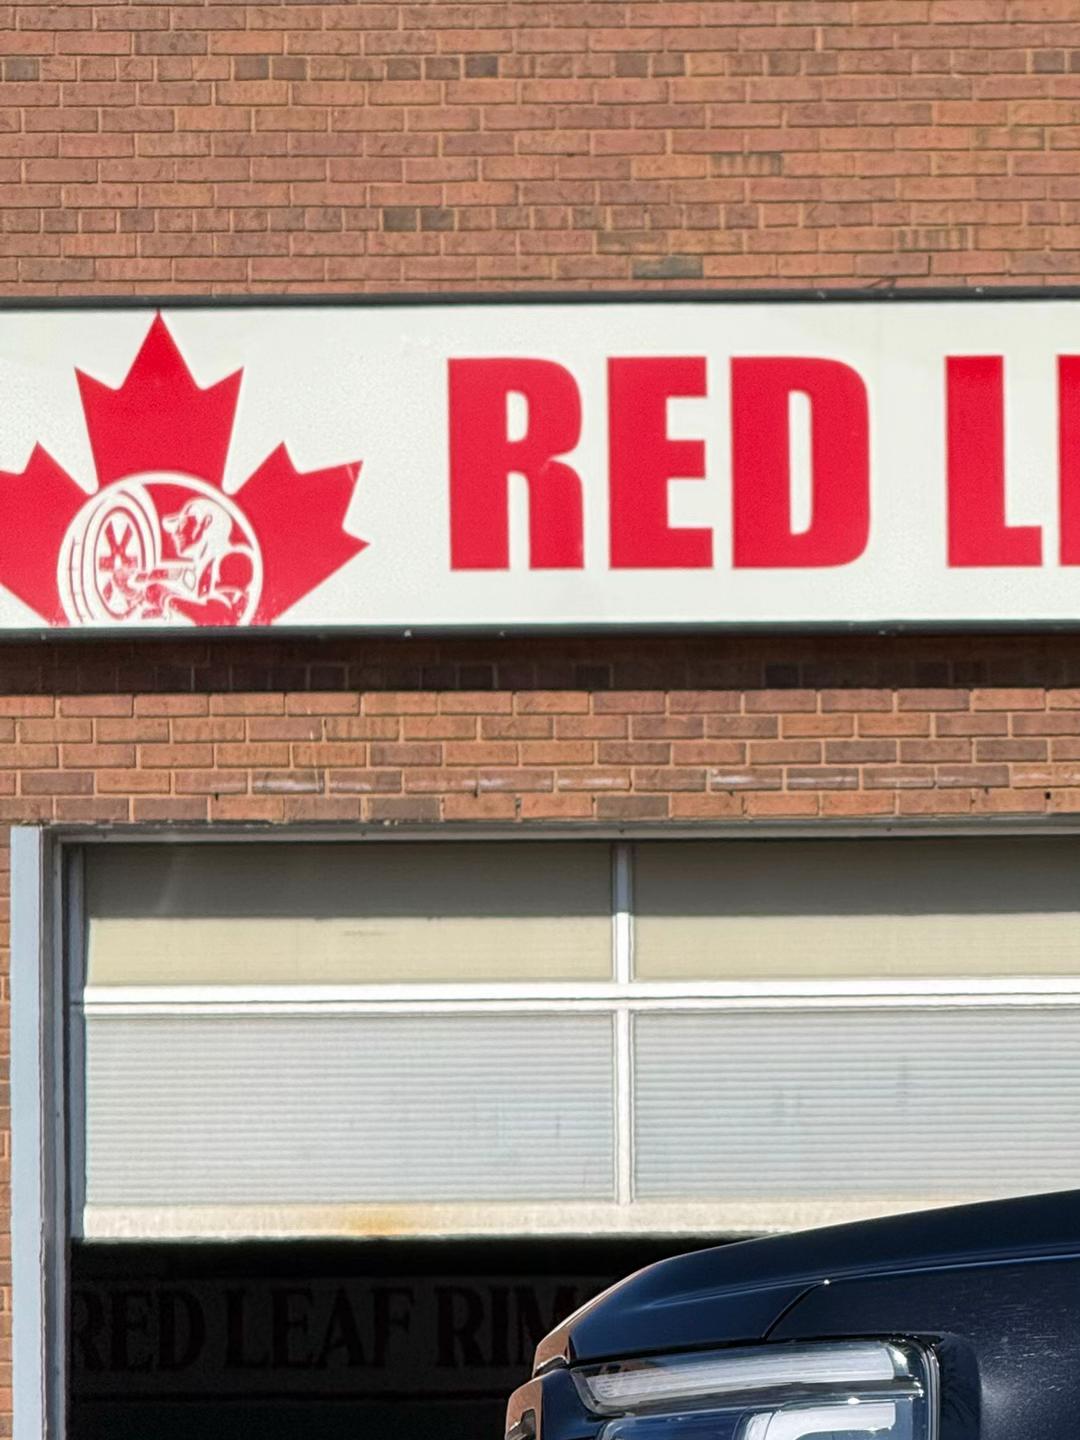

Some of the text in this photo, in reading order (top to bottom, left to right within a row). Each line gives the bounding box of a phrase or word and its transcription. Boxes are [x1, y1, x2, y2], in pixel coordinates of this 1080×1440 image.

[448, 355, 871, 572] RED
[72, 1284, 594, 1371] RED LEAF RIM
